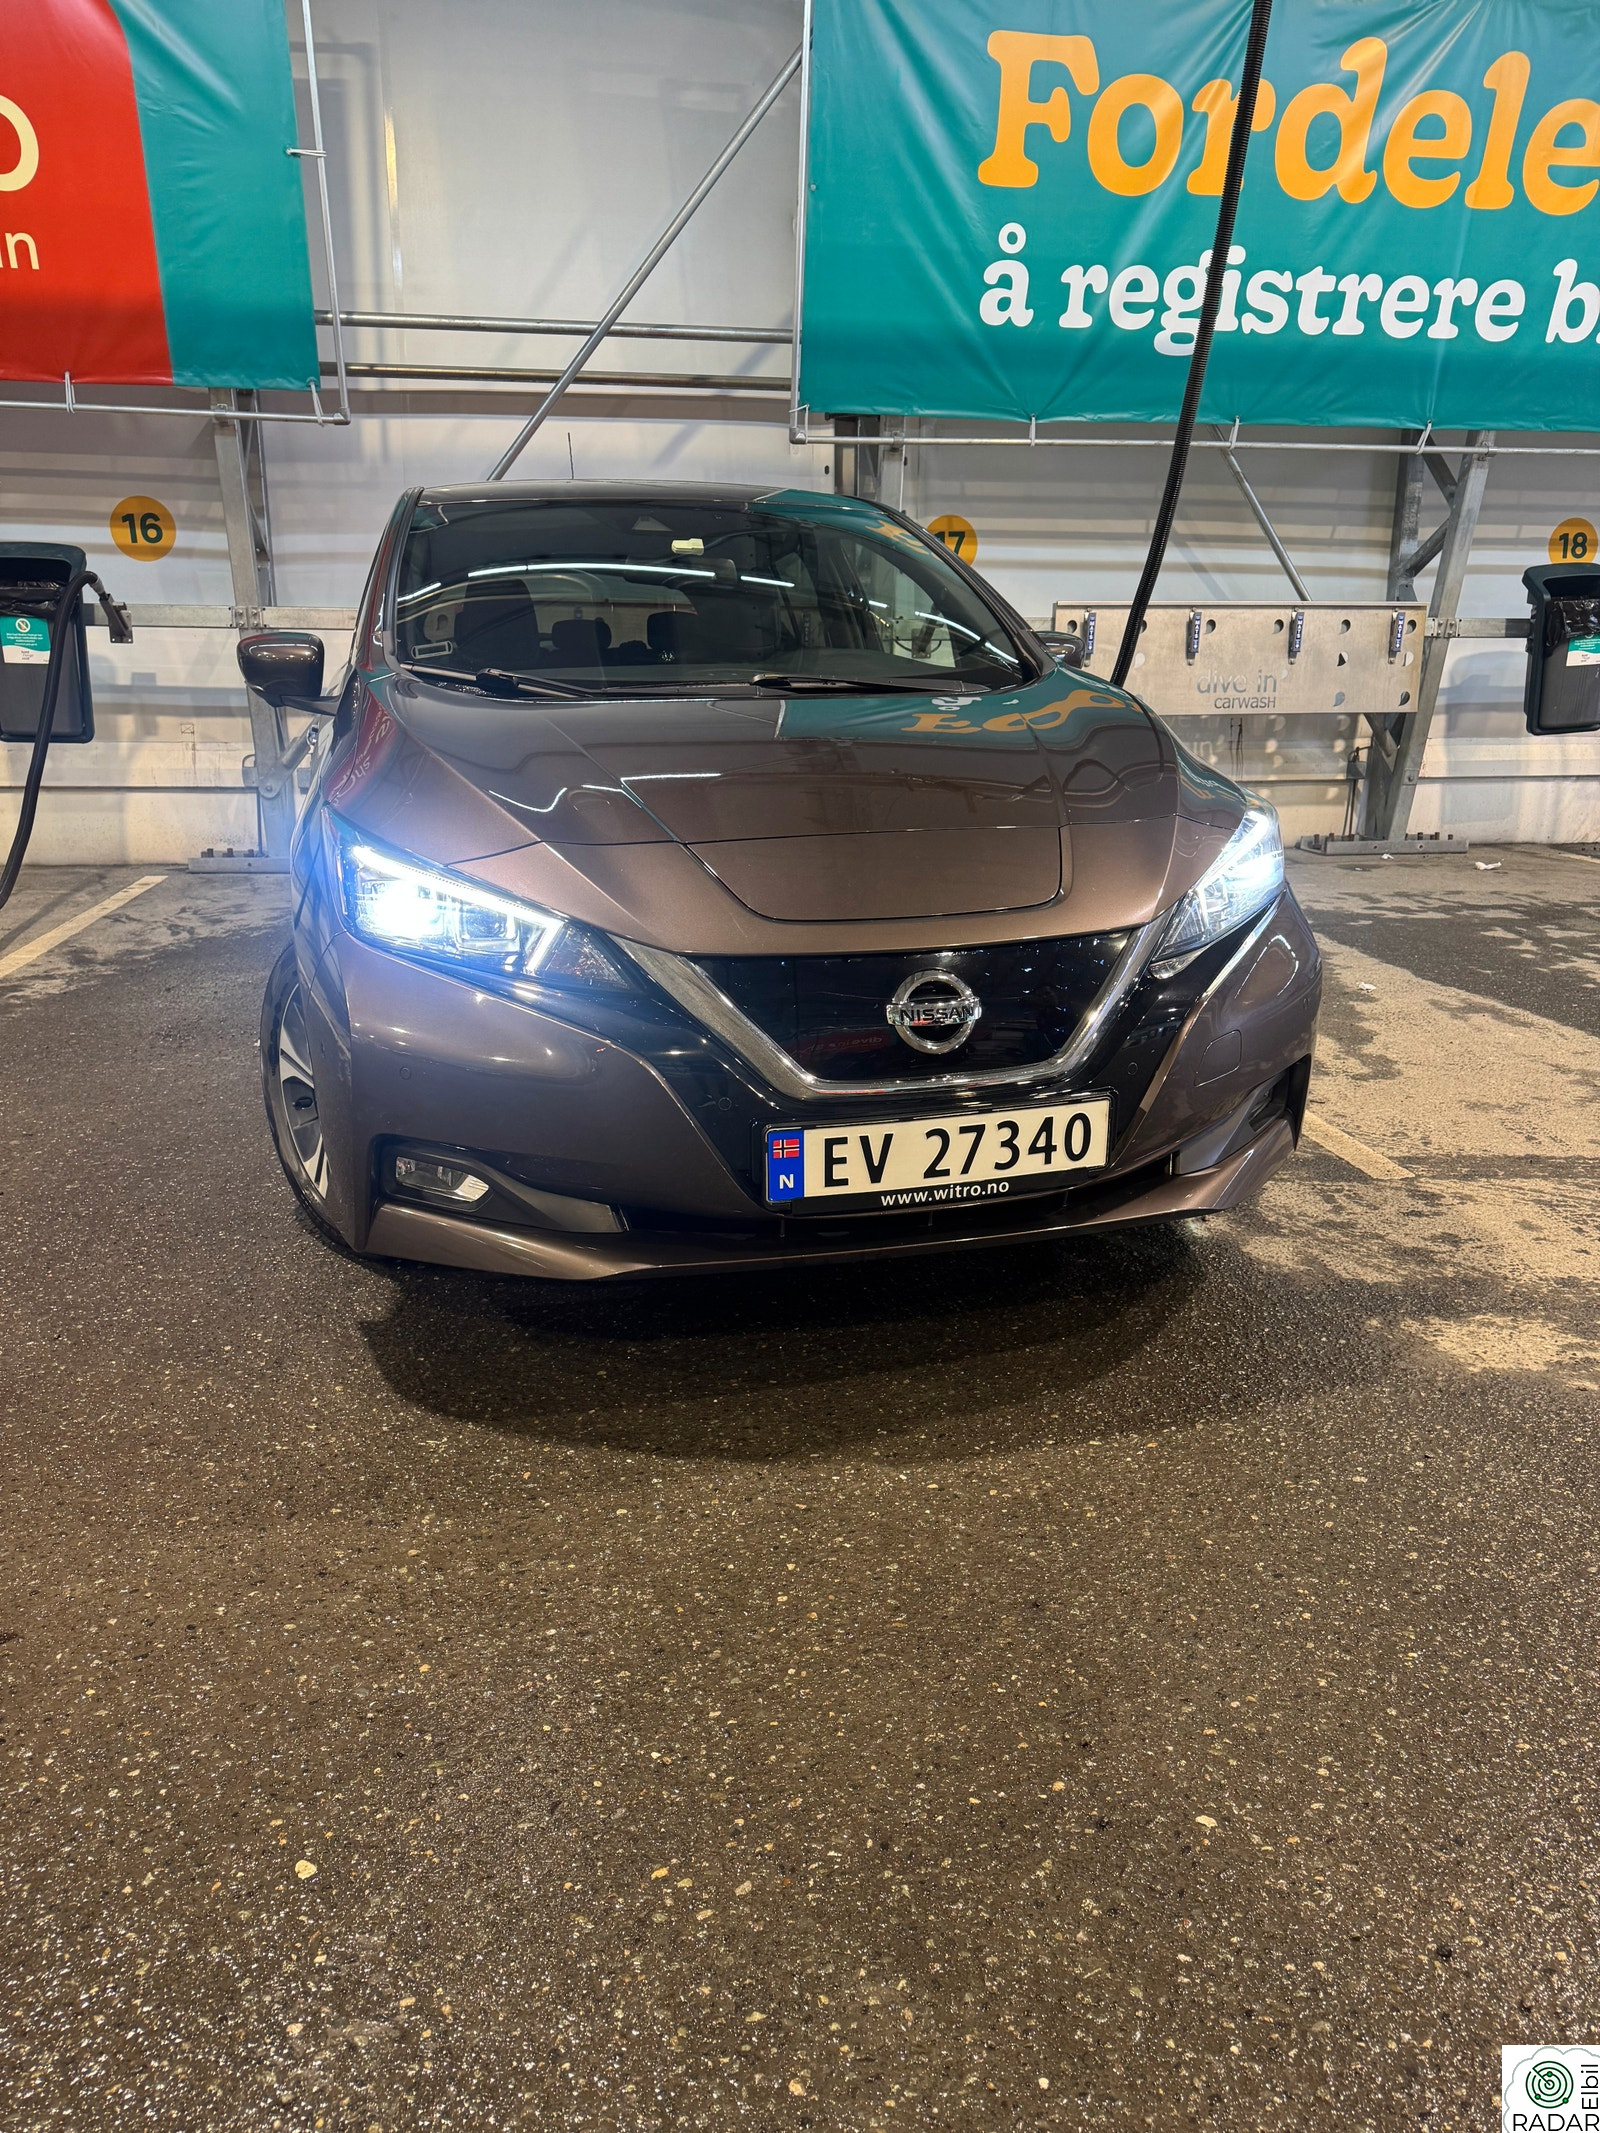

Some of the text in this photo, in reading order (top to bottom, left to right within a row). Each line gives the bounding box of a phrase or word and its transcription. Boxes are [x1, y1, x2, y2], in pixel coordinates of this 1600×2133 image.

[979, 222, 1600, 356] å registrere b
[121, 512, 163, 544] 16
[1558, 532, 1588, 559] 18
[1196, 668, 1277, 694] dive in
[901, 1006, 974, 1022] NISSAN
[824, 1112, 1092, 1188] EV 27340
[779, 1173, 795, 1190] N
[880, 1181, 1010, 1206] www.witro.no
